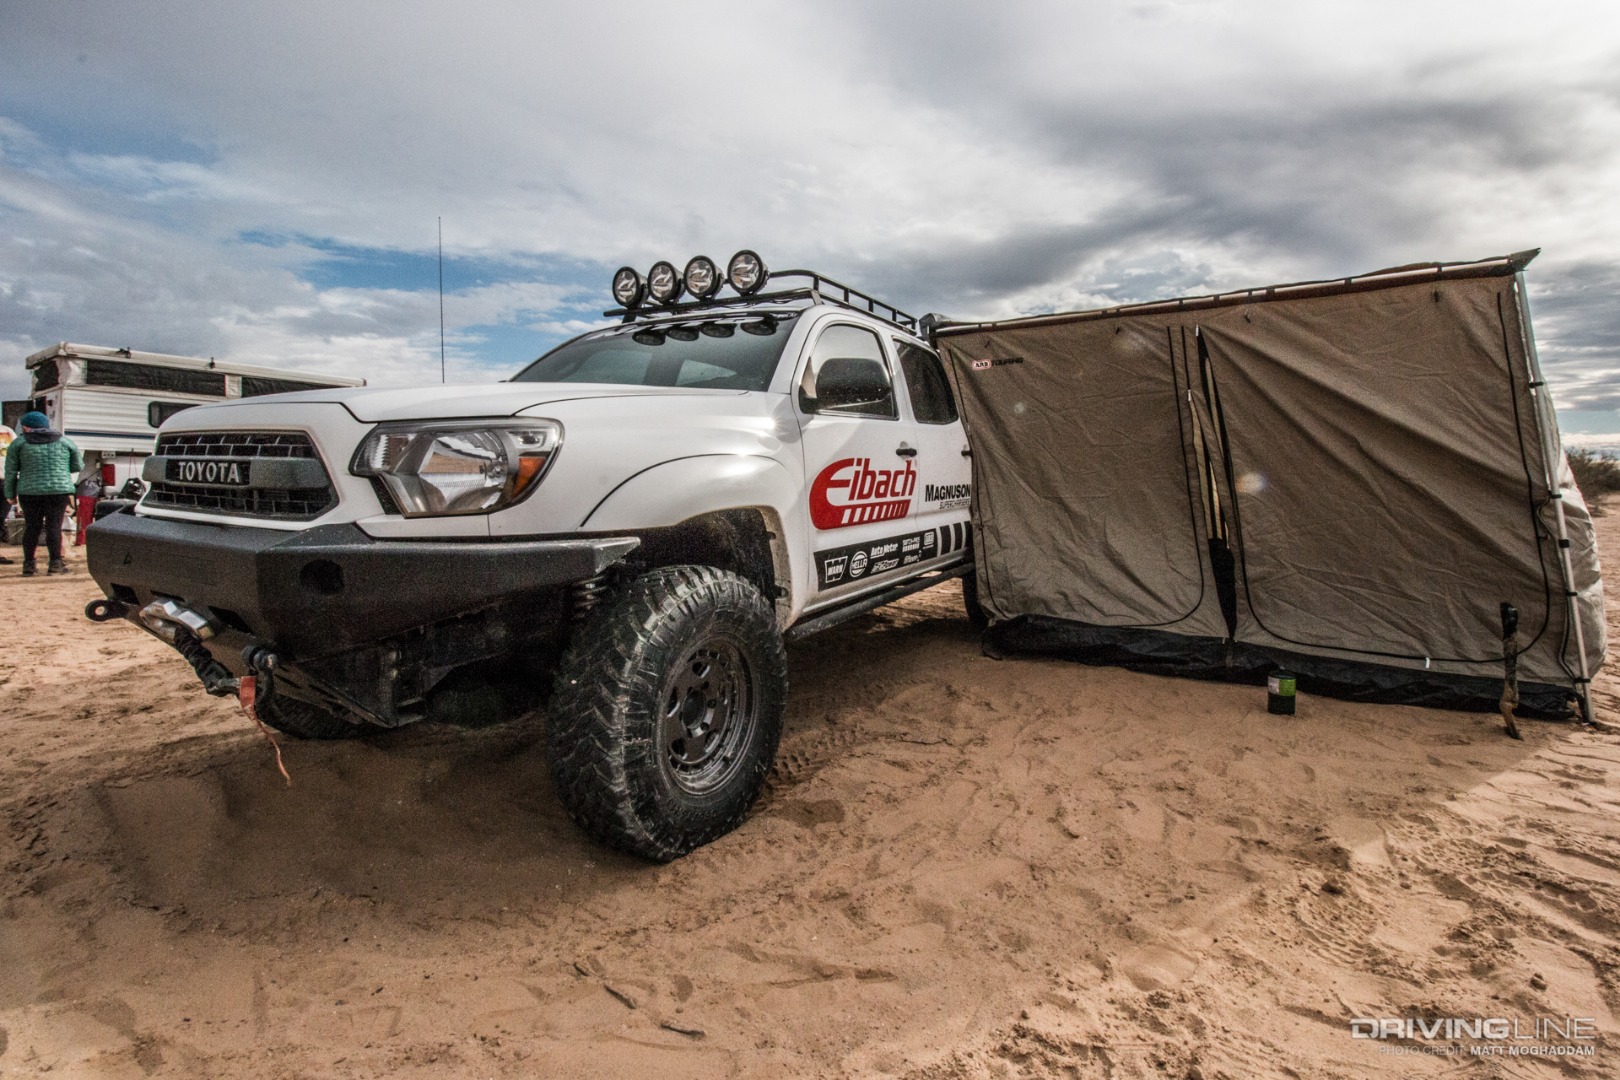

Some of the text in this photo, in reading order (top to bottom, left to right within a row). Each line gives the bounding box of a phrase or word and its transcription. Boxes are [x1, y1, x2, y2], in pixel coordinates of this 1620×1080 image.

[178, 461, 240, 484] TOYOTA
[809, 458, 917, 531] Eibach
[925, 484, 971, 502] MAGNUSON
